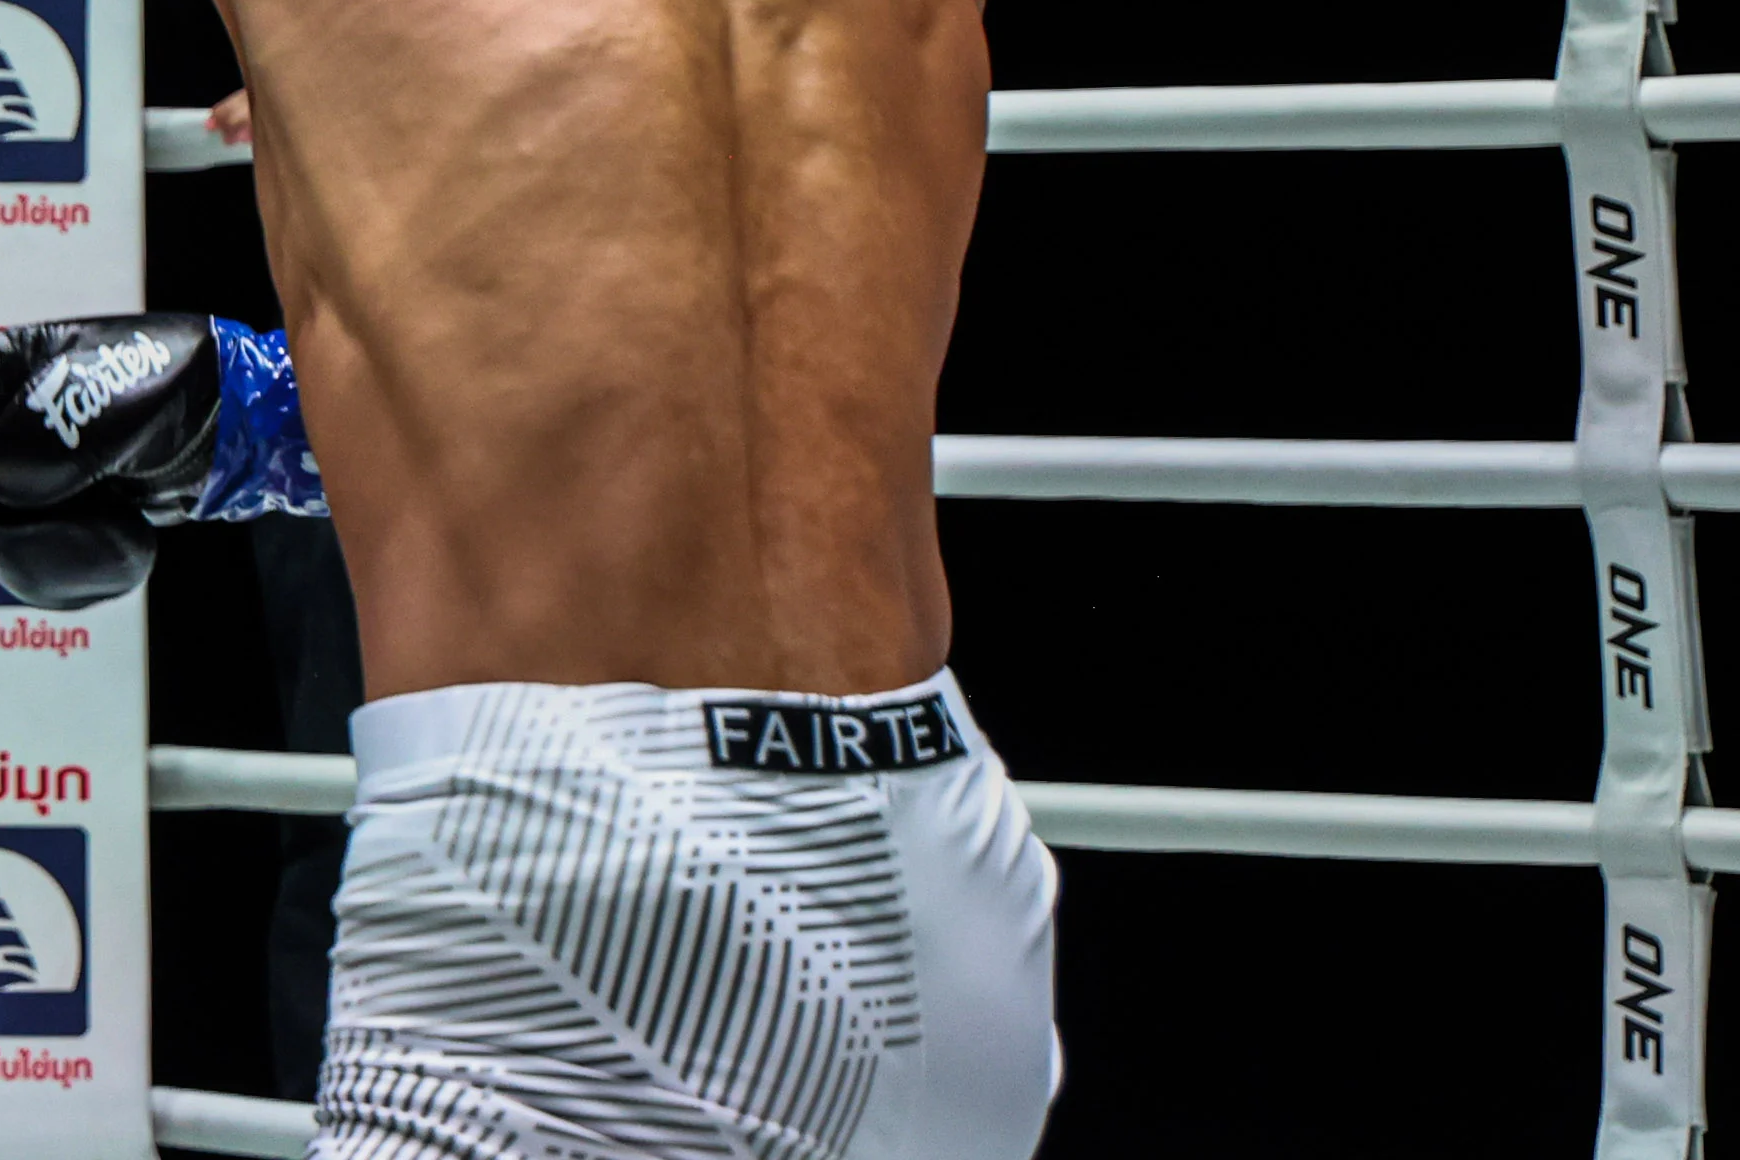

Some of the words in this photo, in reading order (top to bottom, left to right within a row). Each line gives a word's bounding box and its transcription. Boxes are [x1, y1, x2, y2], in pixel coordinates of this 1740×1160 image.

[1586, 194, 1647, 340] ONE
[26, 331, 171, 449] Fairtex
[1606, 561, 1660, 711] ONE
[1615, 924, 1674, 1076] ONE
